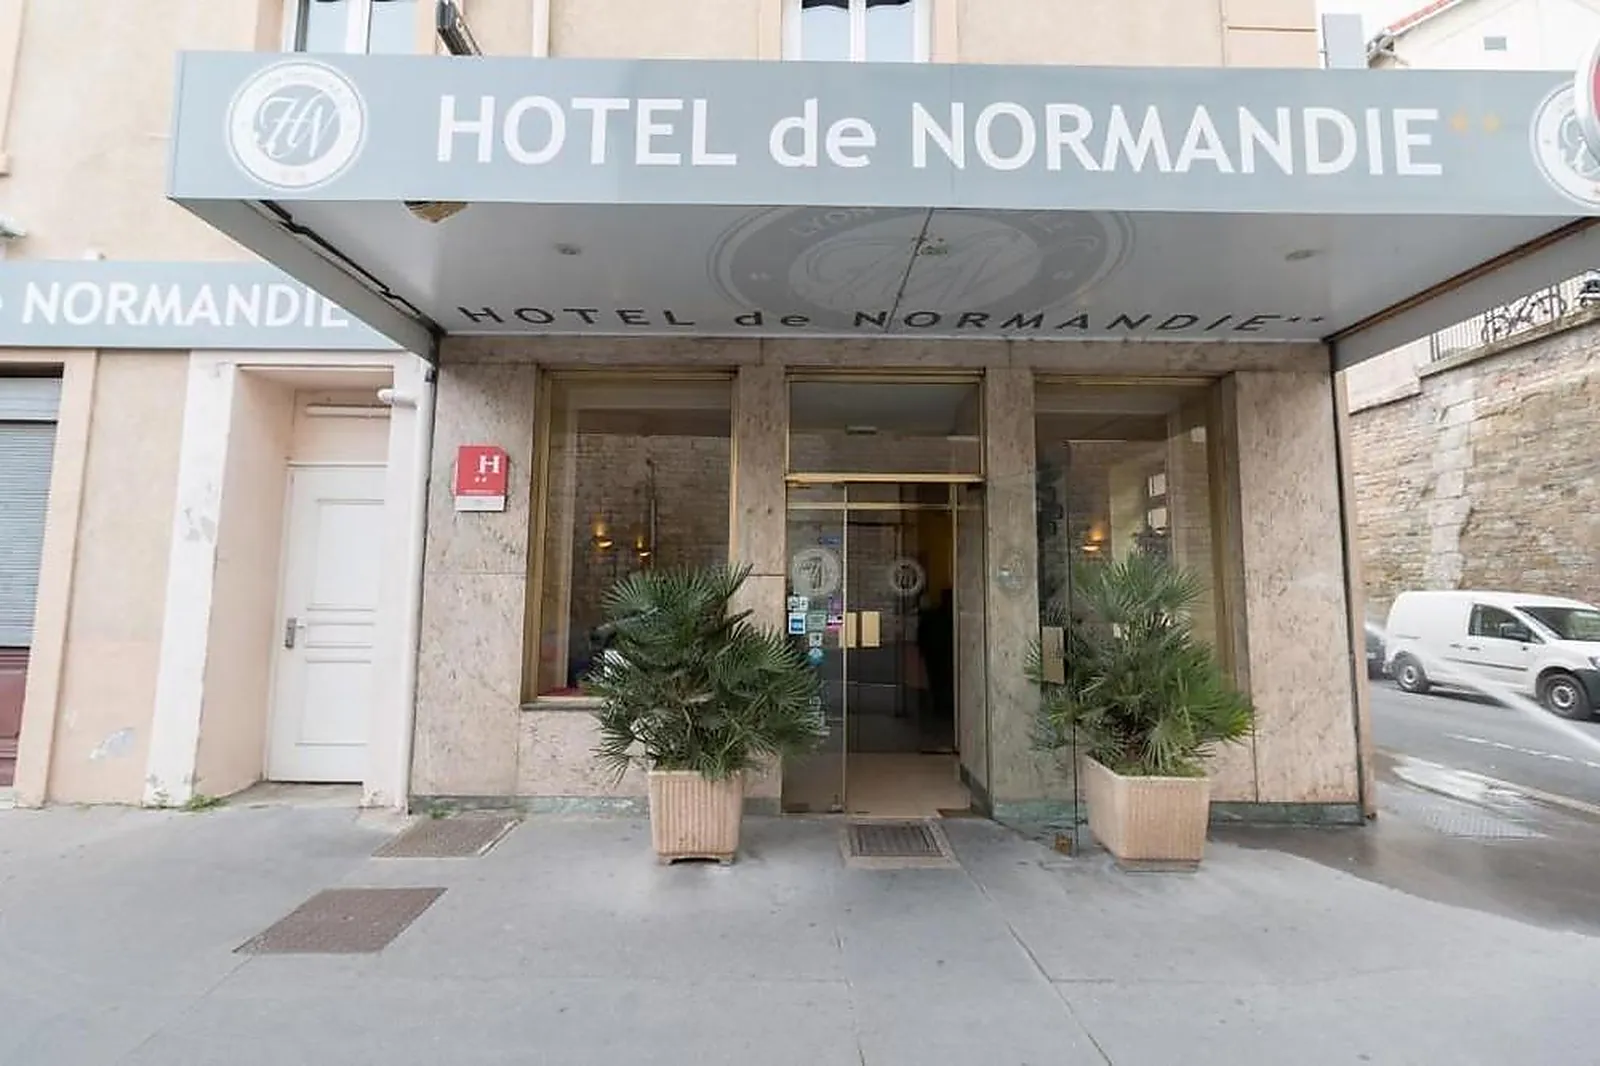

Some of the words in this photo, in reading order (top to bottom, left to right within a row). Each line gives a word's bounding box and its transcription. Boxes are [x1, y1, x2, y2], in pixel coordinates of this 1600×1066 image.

[437, 95, 738, 165] HOTEL
[769, 98, 877, 168] de
[912, 102, 1443, 175] NORMANDIE
[457, 307, 696, 325] HOTEL
[734, 311, 811, 327] de
[852, 310, 1281, 332] NORMANDIE
[478, 455, 501, 474] H
